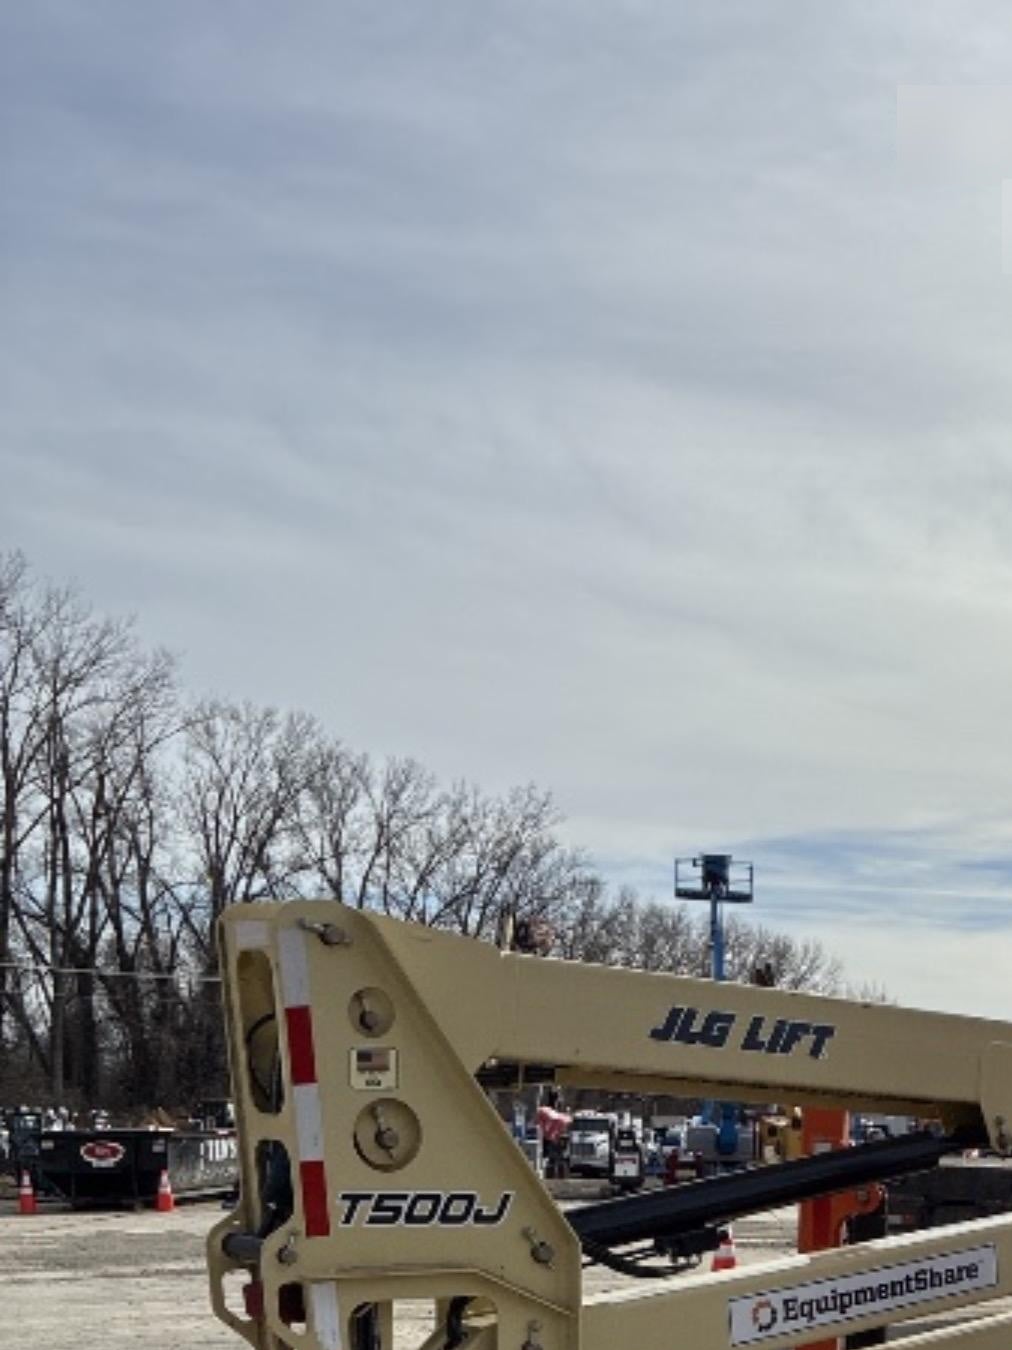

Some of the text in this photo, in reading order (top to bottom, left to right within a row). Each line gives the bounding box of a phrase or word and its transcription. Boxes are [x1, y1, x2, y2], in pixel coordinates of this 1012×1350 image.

[650, 1006, 835, 1059] JLG LIFT
[339, 1192, 514, 1226] T500J
[783, 1261, 980, 1323] EquipmentShare
